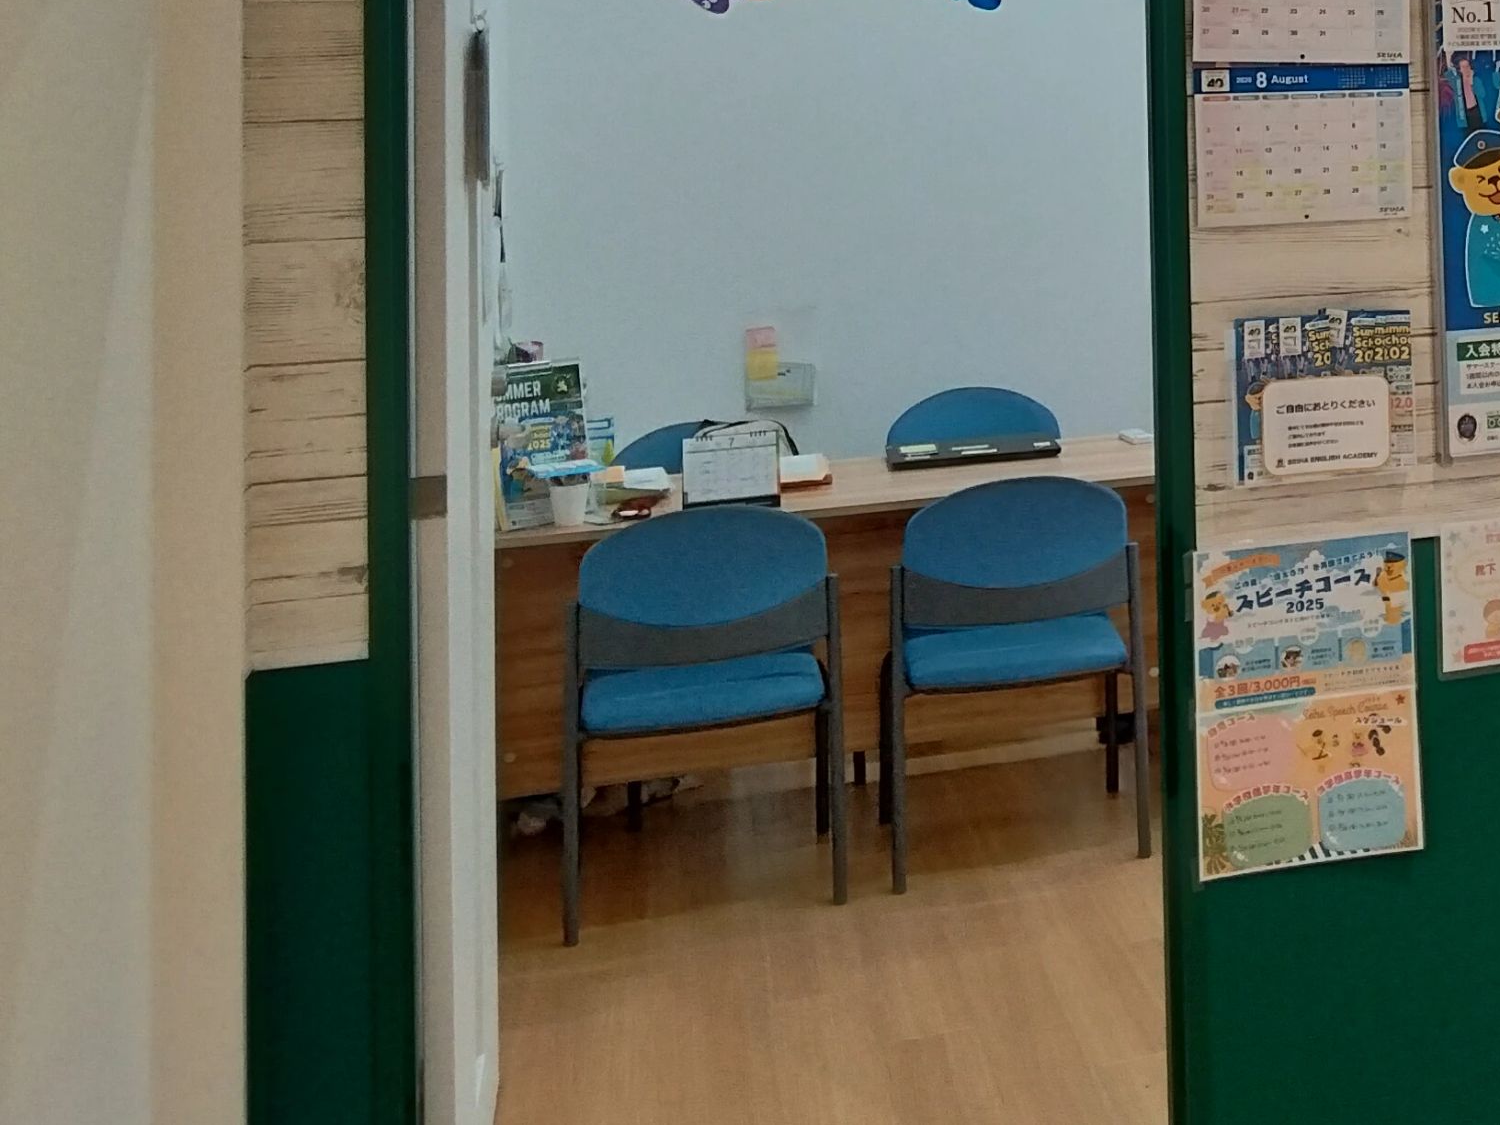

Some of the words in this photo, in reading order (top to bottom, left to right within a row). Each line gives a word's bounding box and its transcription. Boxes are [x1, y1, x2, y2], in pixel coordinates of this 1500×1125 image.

[1452, 2, 1496, 23] No.1
[1256, 72, 1267, 88] 8
[1271, 75, 1308, 84] August
[496, 399, 550, 420] ROGRAM
[1236, 568, 1371, 613] スピーチコース
[1286, 598, 1324, 613] 2025
